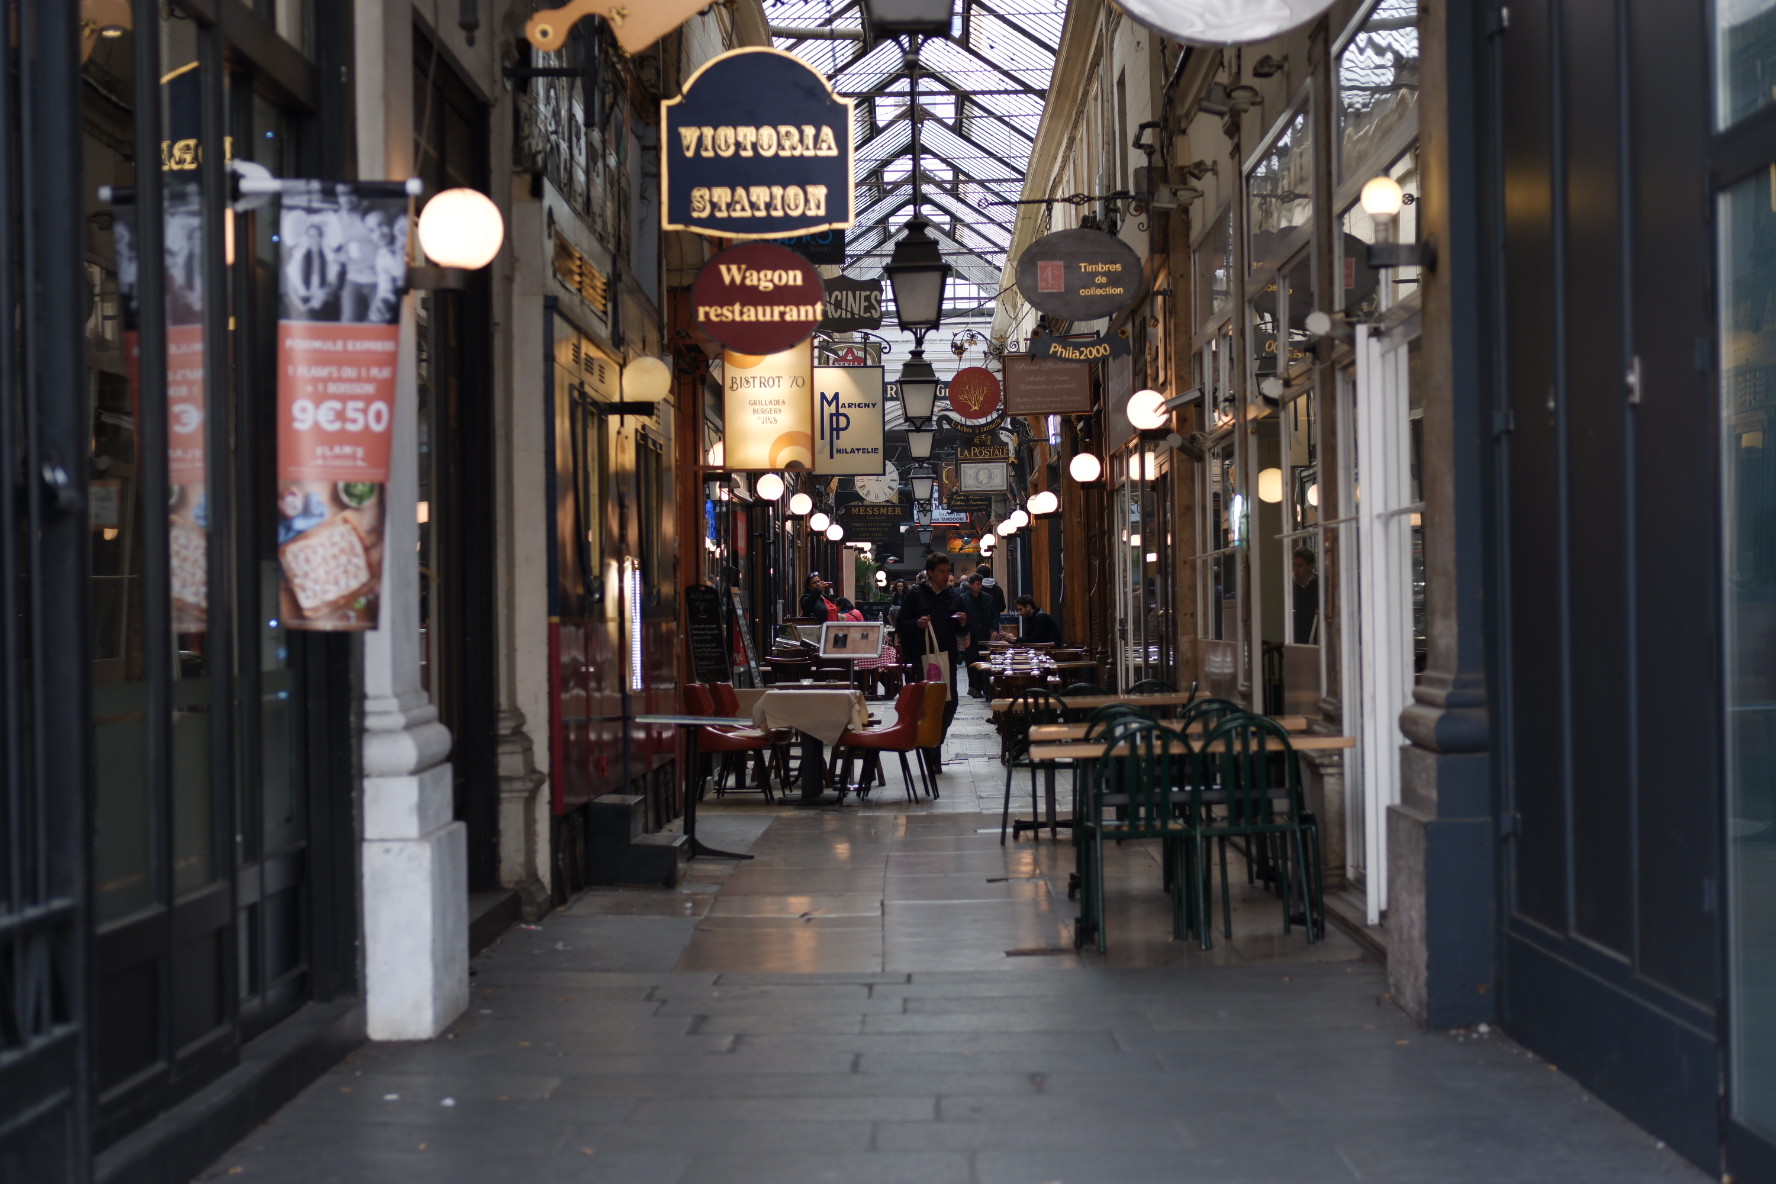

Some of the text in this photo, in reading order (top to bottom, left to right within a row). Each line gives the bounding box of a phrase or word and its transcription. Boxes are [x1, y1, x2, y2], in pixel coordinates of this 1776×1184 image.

[678, 125, 839, 158] VICTORIA
[690, 184, 828, 218] STATION
[1079, 262, 1122, 273] Timbres
[718, 264, 803, 292] Wagon
[1095, 275, 1107, 284] de
[1079, 286, 1124, 296] collection
[697, 300, 824, 322] restaurant
[1049, 342, 1110, 360] Phila2000
[729, 375, 805, 391] BISTROT 70
[748, 399, 786, 407] GRILLADES
[291, 399, 390, 433] 9€50
[752, 407, 782, 415] BURGERS
[957, 446, 1009, 457] LA POSTALE
[851, 506, 902, 515] MESSMER
